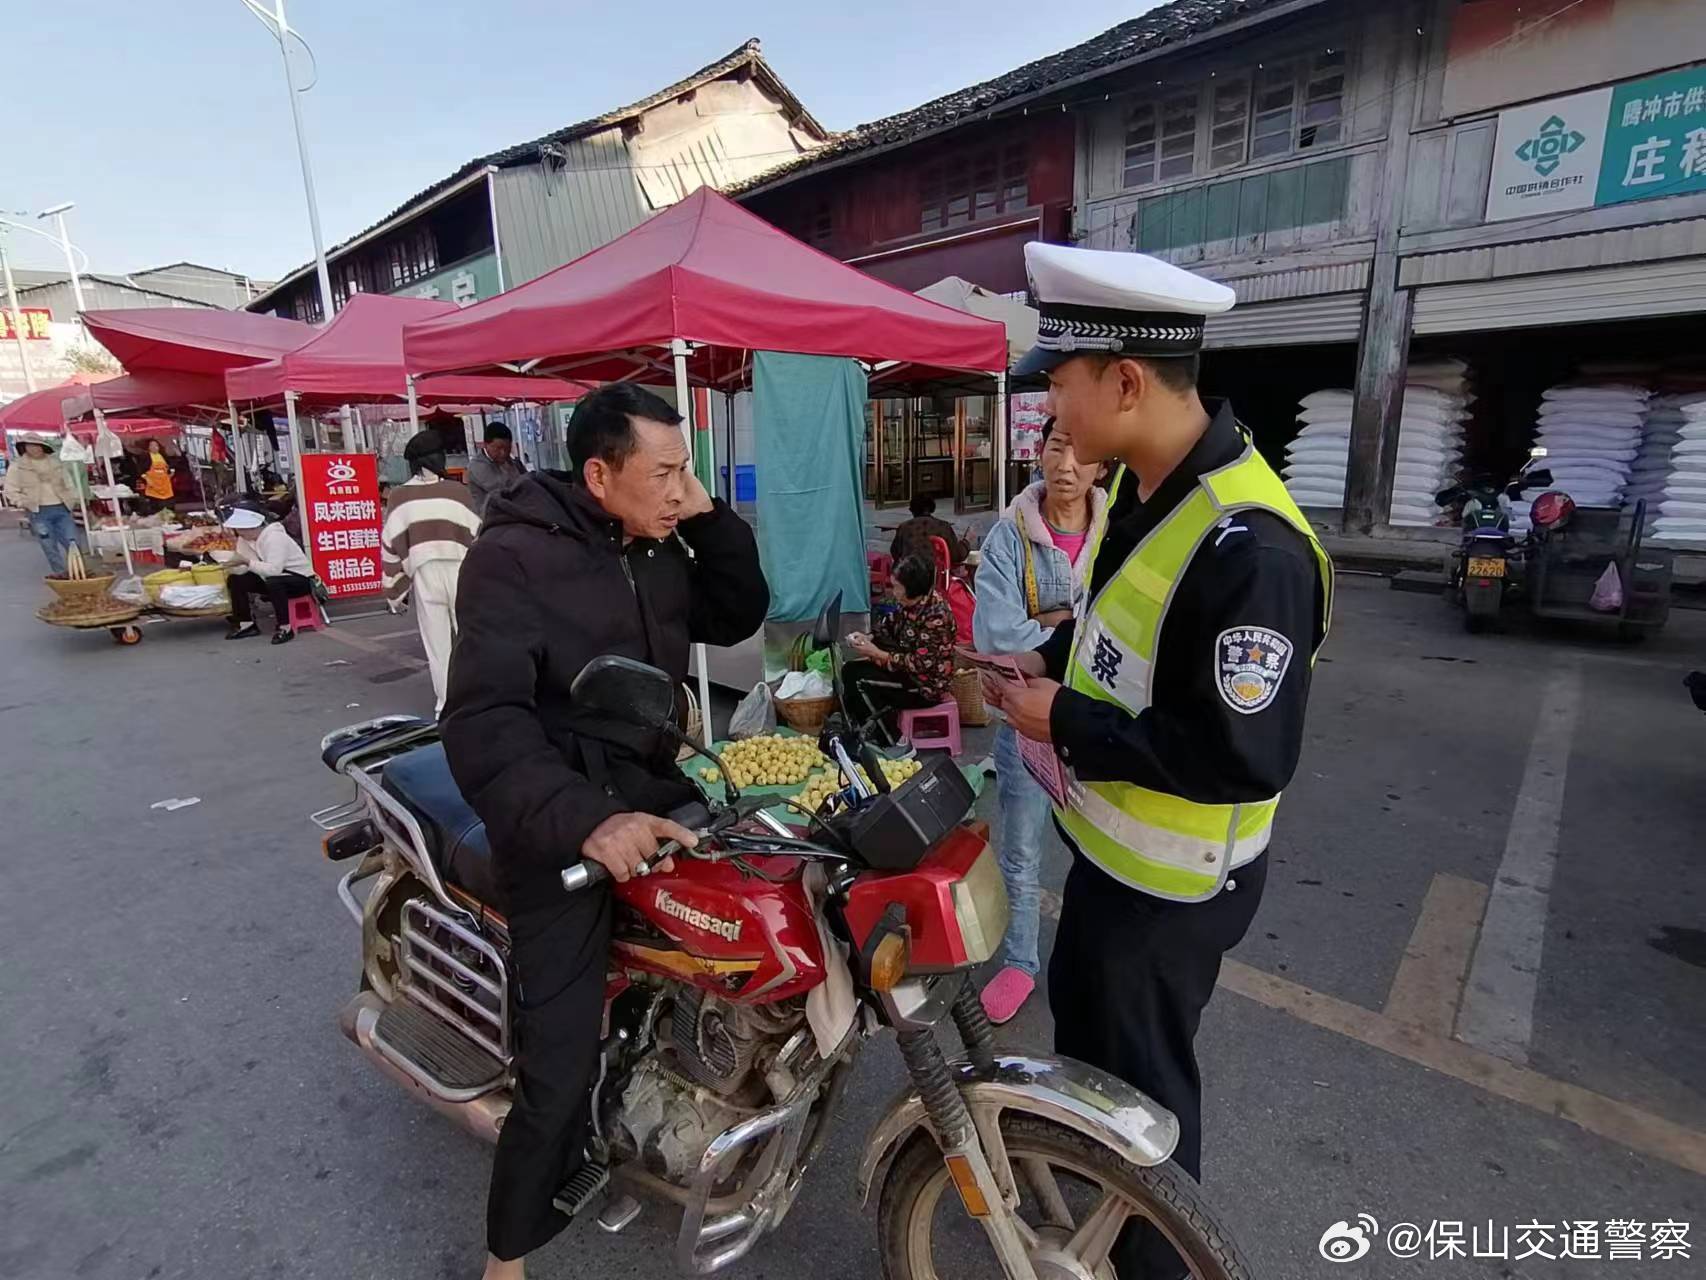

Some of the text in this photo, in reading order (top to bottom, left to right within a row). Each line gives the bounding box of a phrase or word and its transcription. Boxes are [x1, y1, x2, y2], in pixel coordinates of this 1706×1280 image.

[1621, 86, 1706, 127] 腾冲市供
[314, 500, 377, 522] 凤来西饼
[317, 528, 380, 551] 生日蛋糕
[328, 557, 375, 580] 甜品台
[1222, 630, 1288, 656] 中华人民共和国
[1091, 633, 1123, 689] 察
[655, 888, 744, 942] Kamasaqi
